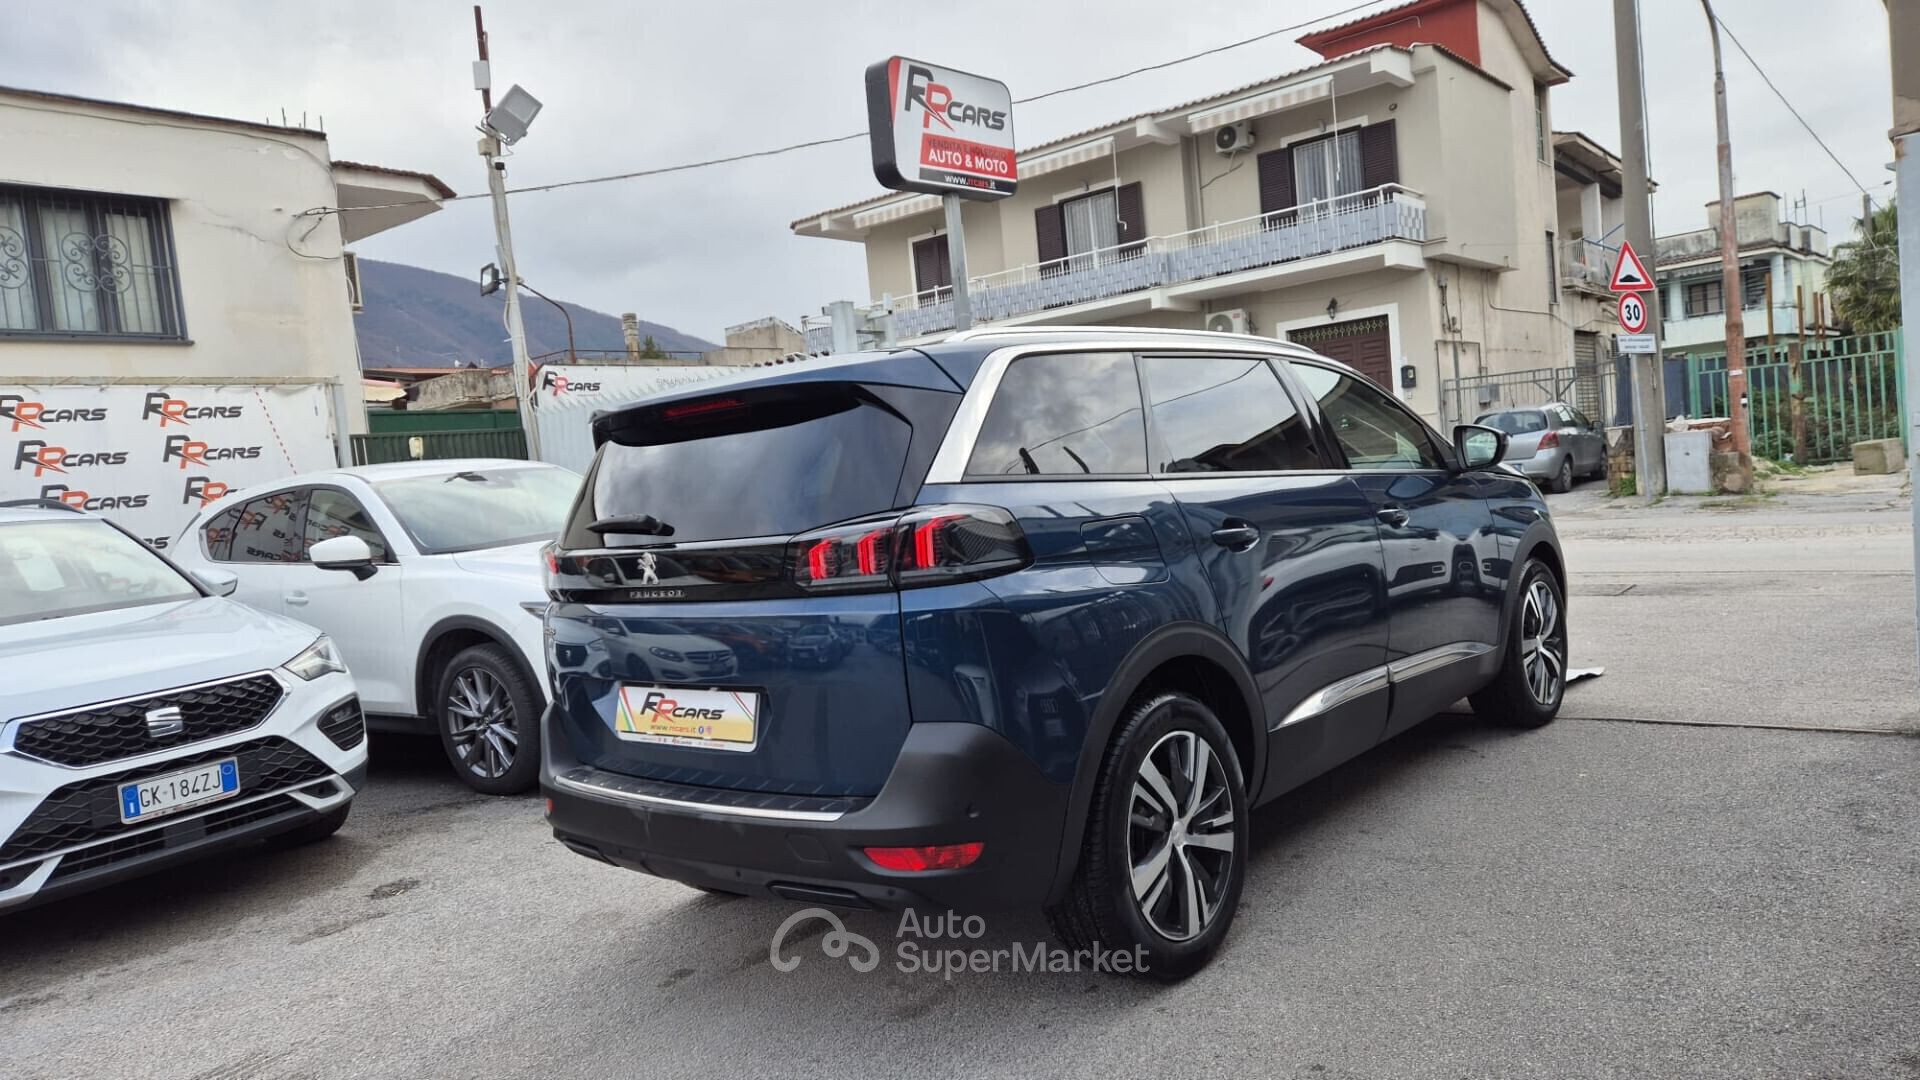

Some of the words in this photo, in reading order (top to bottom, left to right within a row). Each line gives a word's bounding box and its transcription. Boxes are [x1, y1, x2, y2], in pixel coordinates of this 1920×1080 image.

[928, 148, 962, 166] AUTO
[965, 154, 973, 168] &
[974, 156, 1008, 174] MOTO
[1624, 304, 1640, 321] 30
